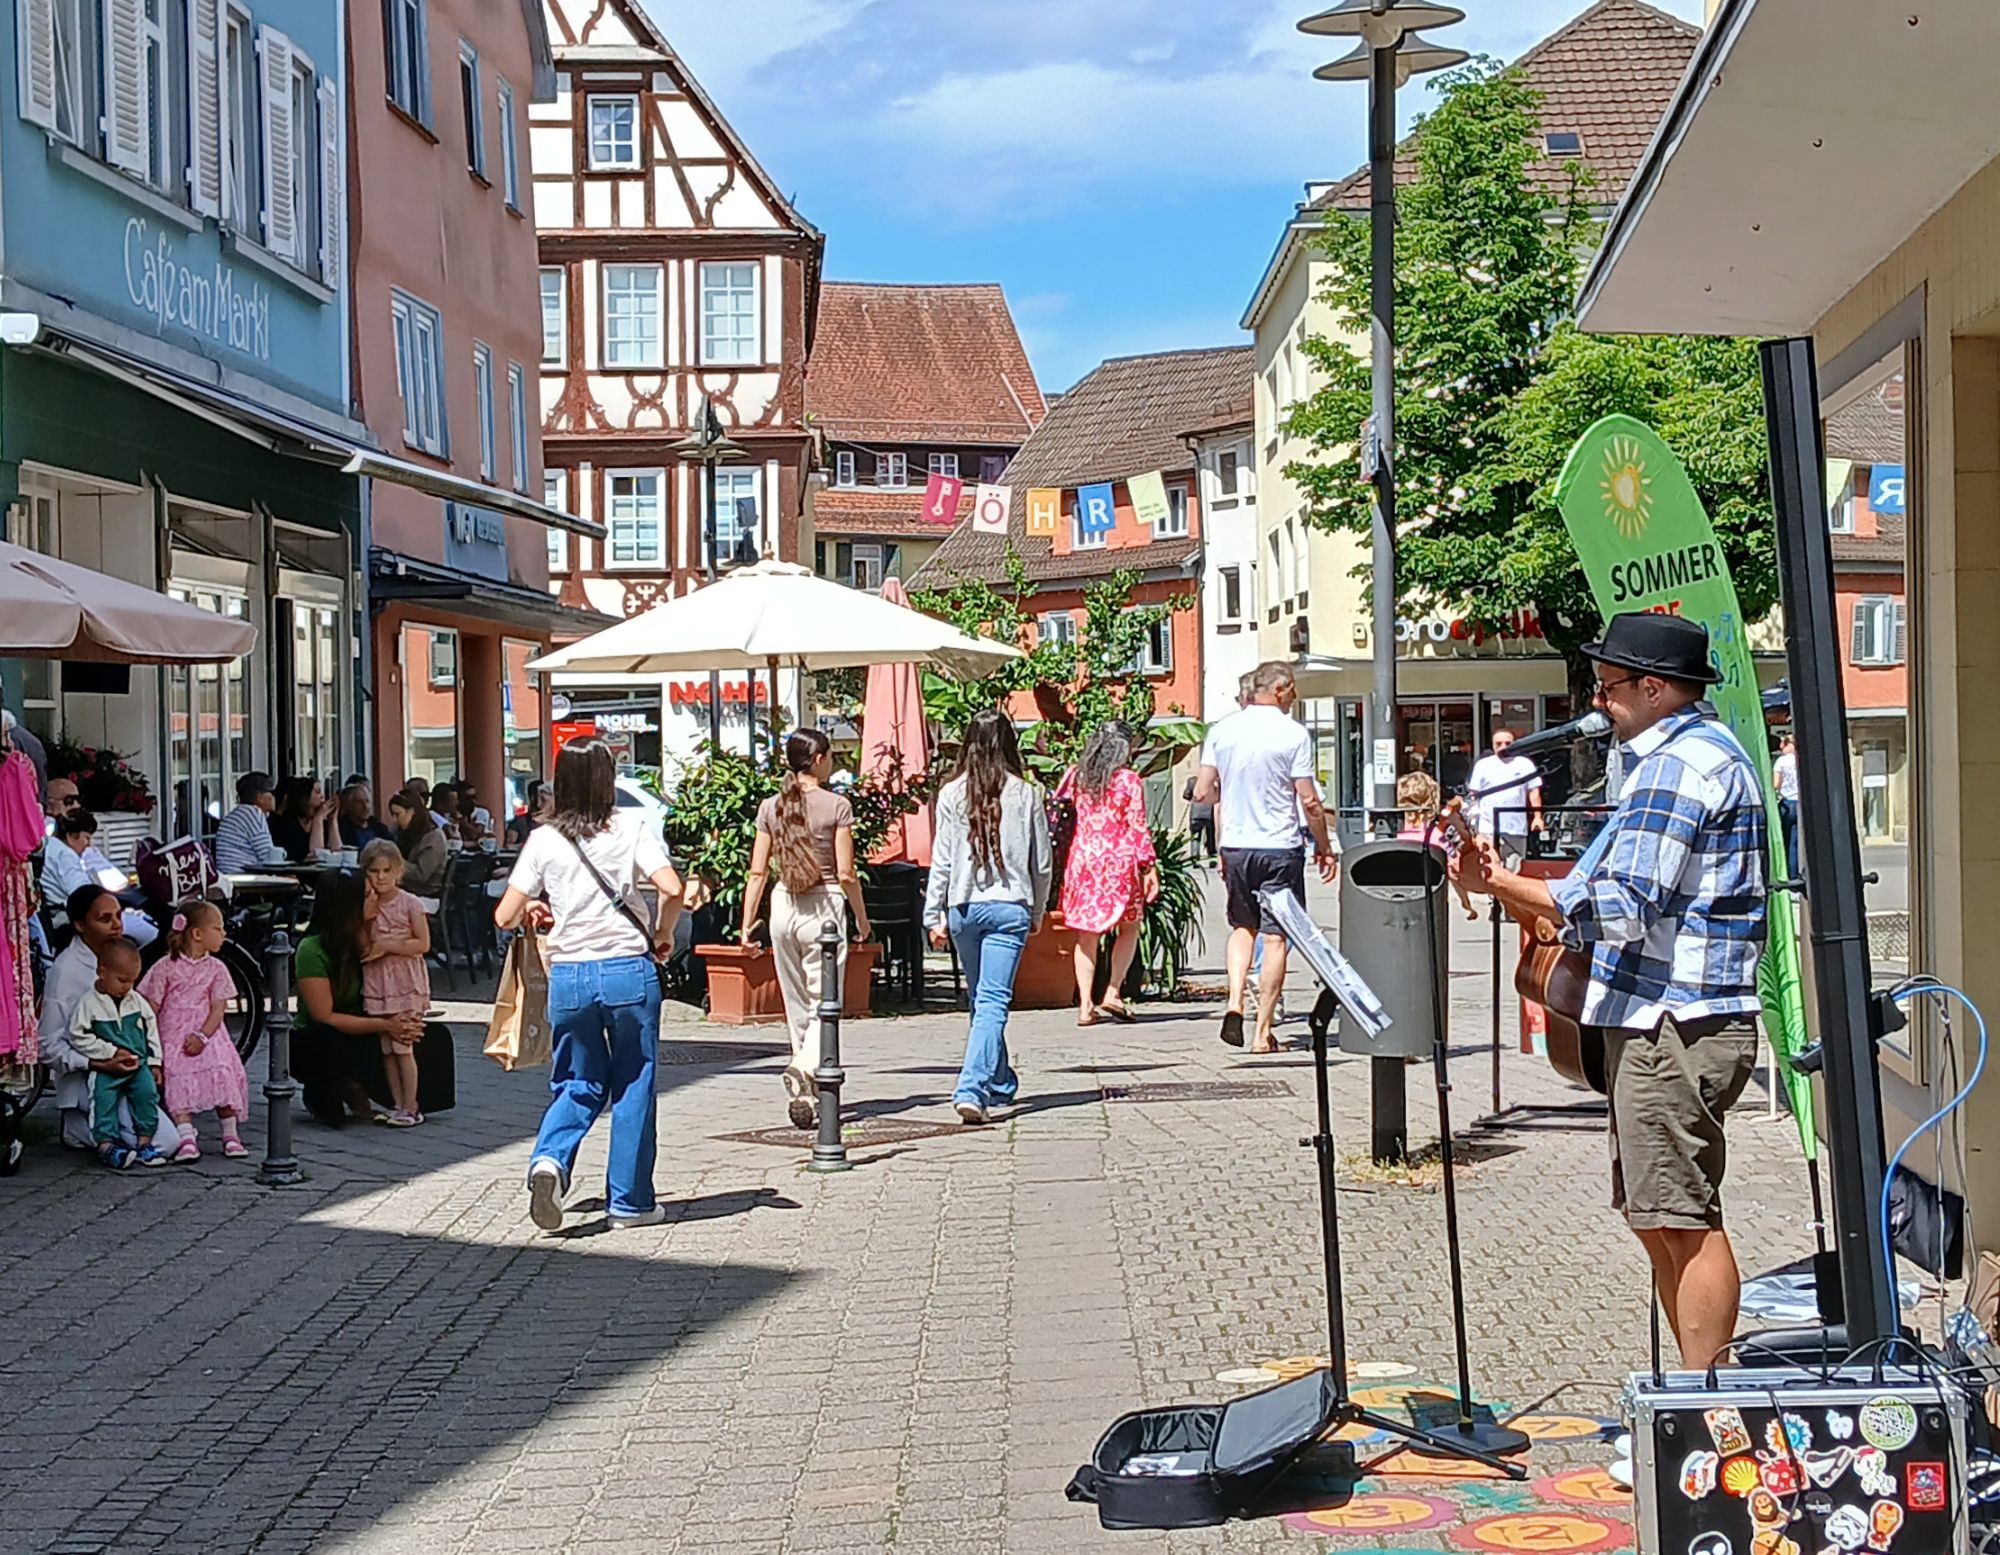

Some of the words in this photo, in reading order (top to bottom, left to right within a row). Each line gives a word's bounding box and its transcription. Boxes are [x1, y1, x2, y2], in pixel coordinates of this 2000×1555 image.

[125, 217, 177, 335] Café
[179, 266, 210, 334] am
[213, 262, 269, 360] Markt
[1611, 544, 1720, 602] SOMMER
[1517, 1523, 1563, 1541] 2
